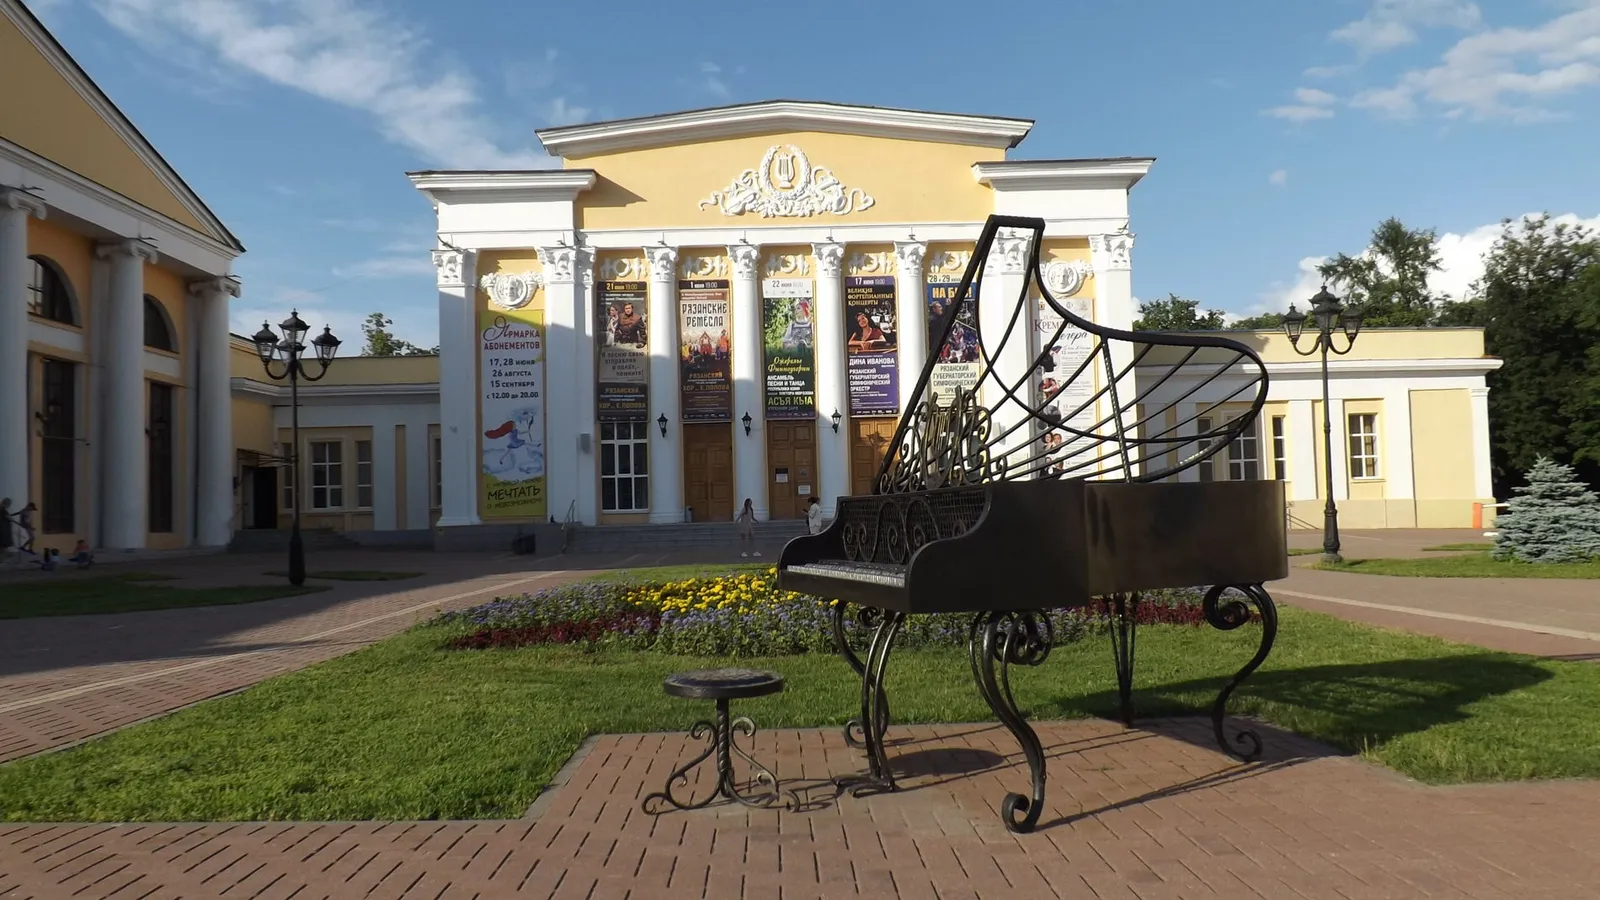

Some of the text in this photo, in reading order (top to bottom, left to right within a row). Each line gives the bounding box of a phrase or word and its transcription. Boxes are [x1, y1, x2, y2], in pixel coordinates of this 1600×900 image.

[932, 287, 972, 298] НА Б!
[682, 303, 727, 314] РЯЗАНСКИЕ
[484, 342, 540, 350] АБОНЕМЕНТОВ
[488, 485, 540, 500] МЕЧТАТЬ
